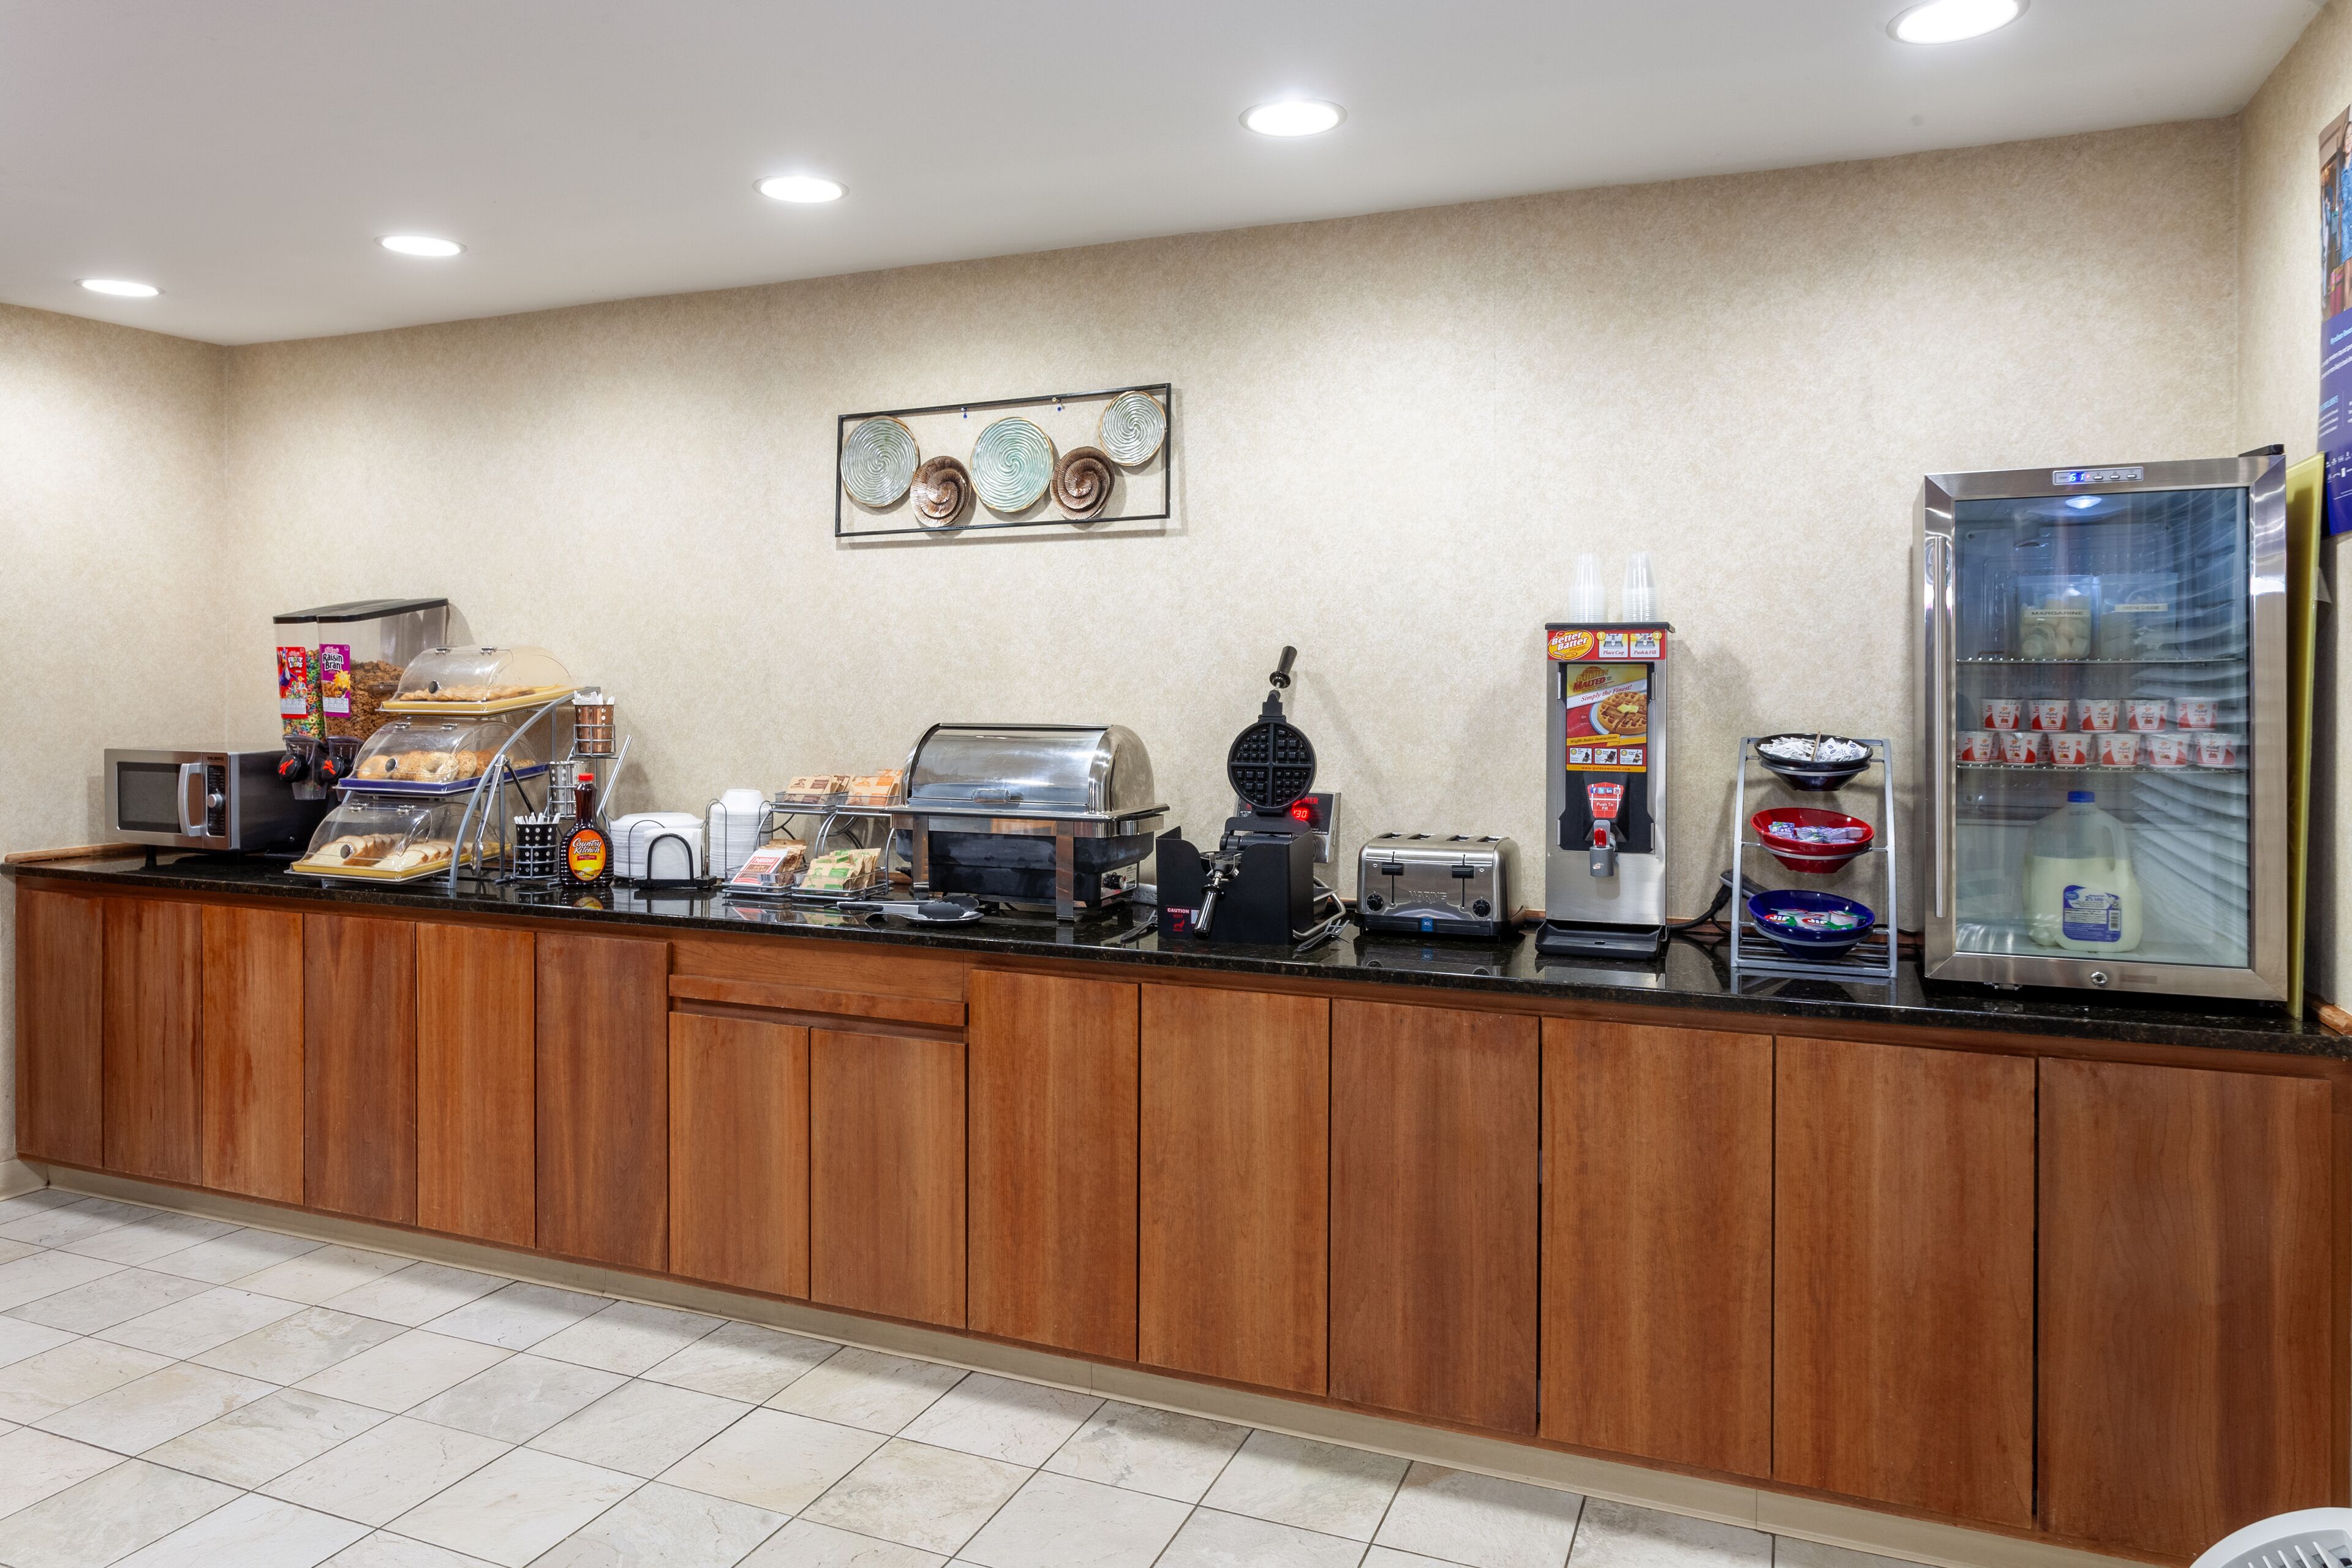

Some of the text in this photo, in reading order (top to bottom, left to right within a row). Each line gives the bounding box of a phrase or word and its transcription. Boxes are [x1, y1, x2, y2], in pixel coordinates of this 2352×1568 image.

[1551, 631, 1583, 646] Better
[1558, 637, 1588, 651] Batter
[323, 653, 343, 663] Raisin
[1576, 668, 1609, 682] GOLDEN
[1573, 677, 1606, 691] MALTED
[1581, 693, 1601, 701] Simply
[1613, 684, 1632, 694] Finest!
[573, 838, 602, 848] Country
[573, 847, 600, 856] Kitchen
